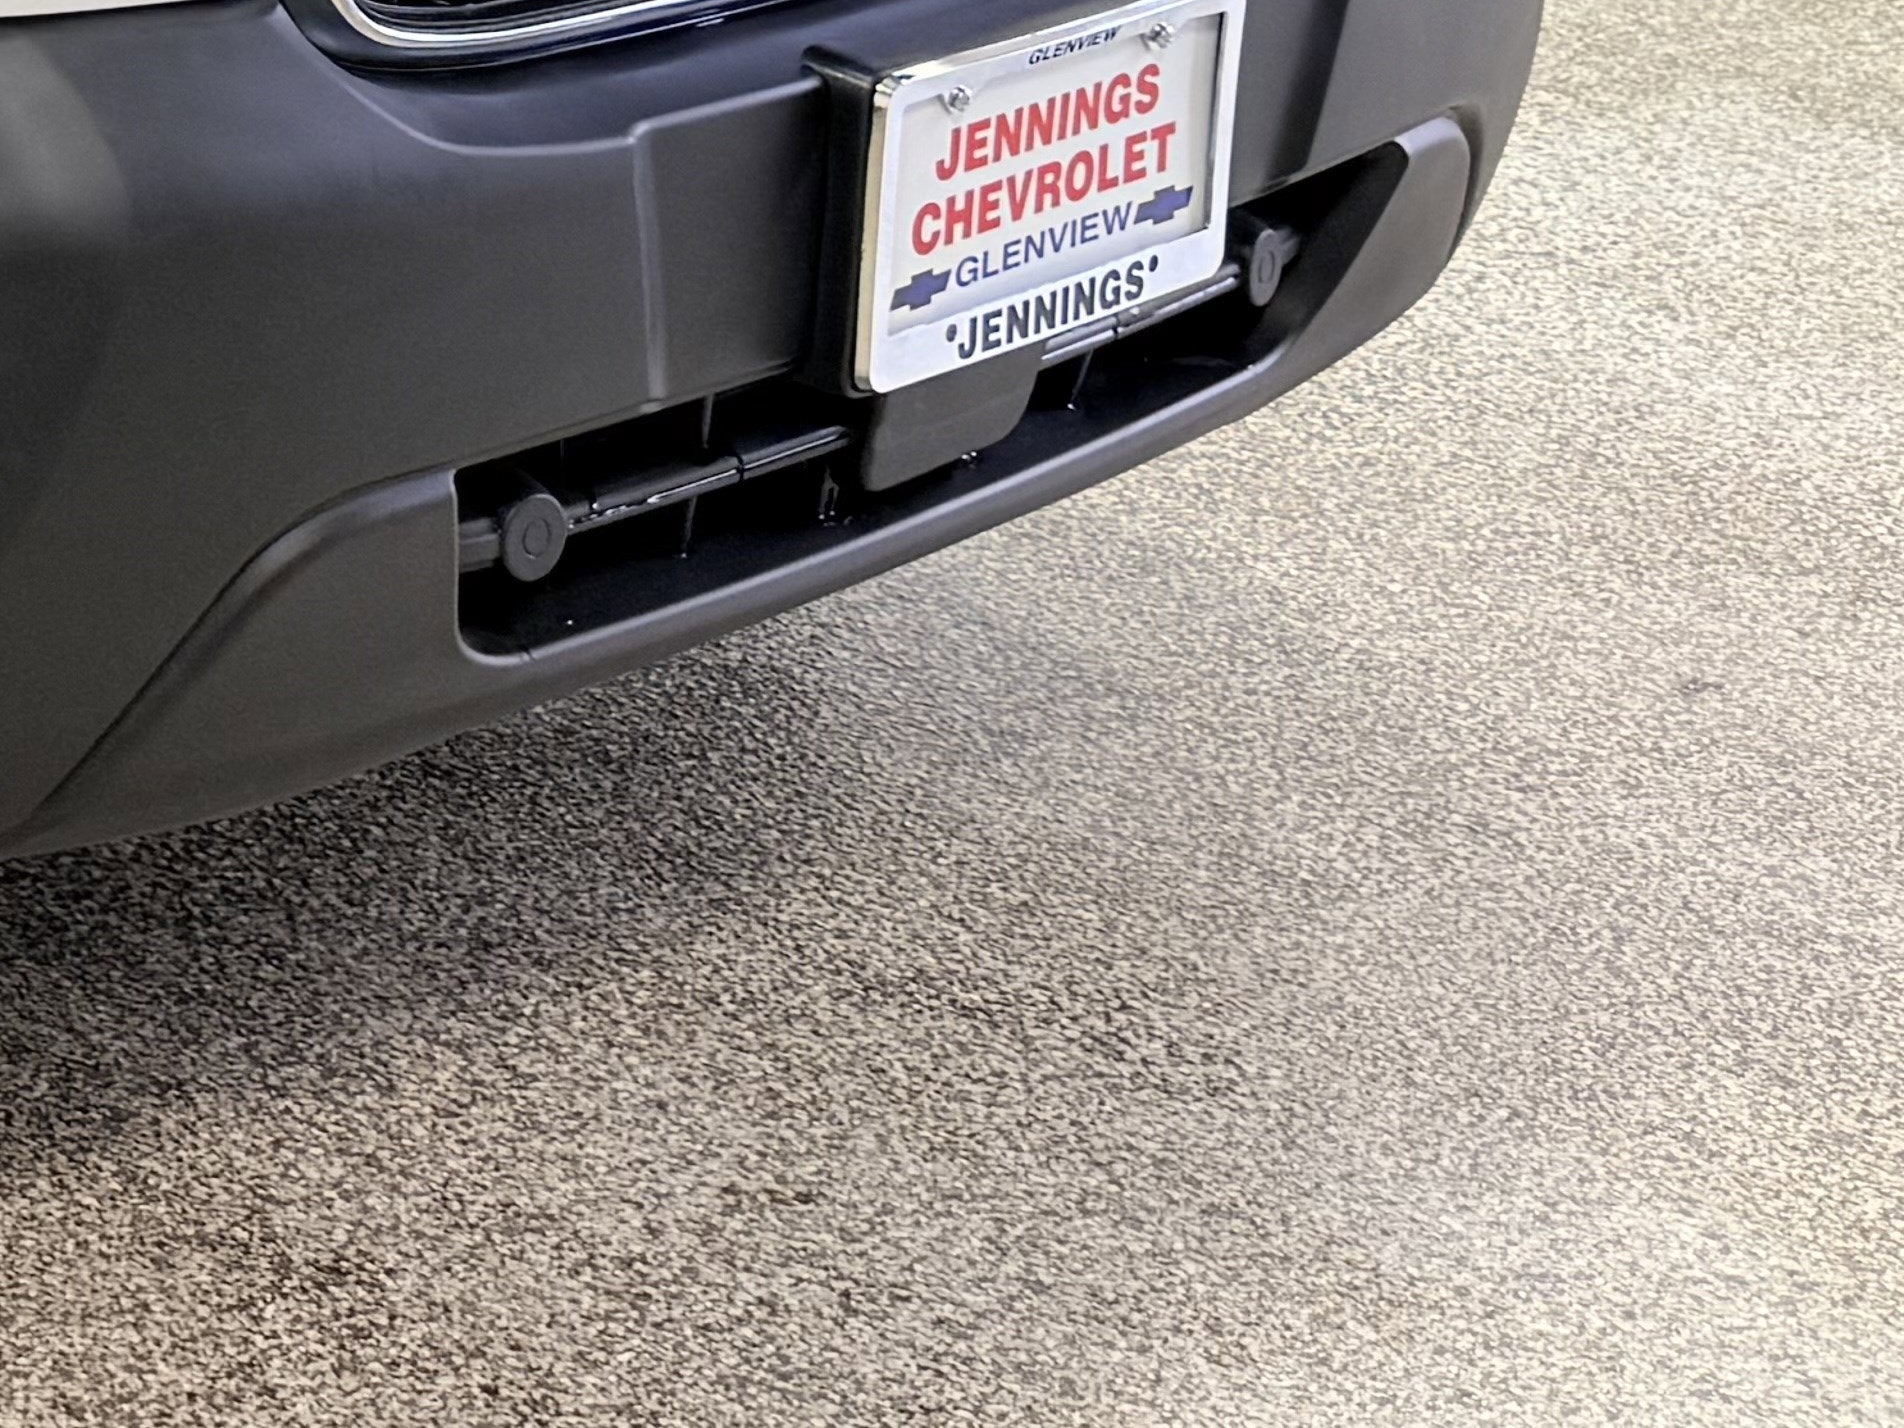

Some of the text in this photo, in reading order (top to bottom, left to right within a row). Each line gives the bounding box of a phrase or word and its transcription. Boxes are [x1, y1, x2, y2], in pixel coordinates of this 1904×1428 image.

[1028, 25, 1122, 65] GLENVIEW
[935, 63, 1161, 181] JENNINGS
[911, 121, 1177, 256] CHEVROLET
[955, 201, 1133, 287] GLENVIEW
